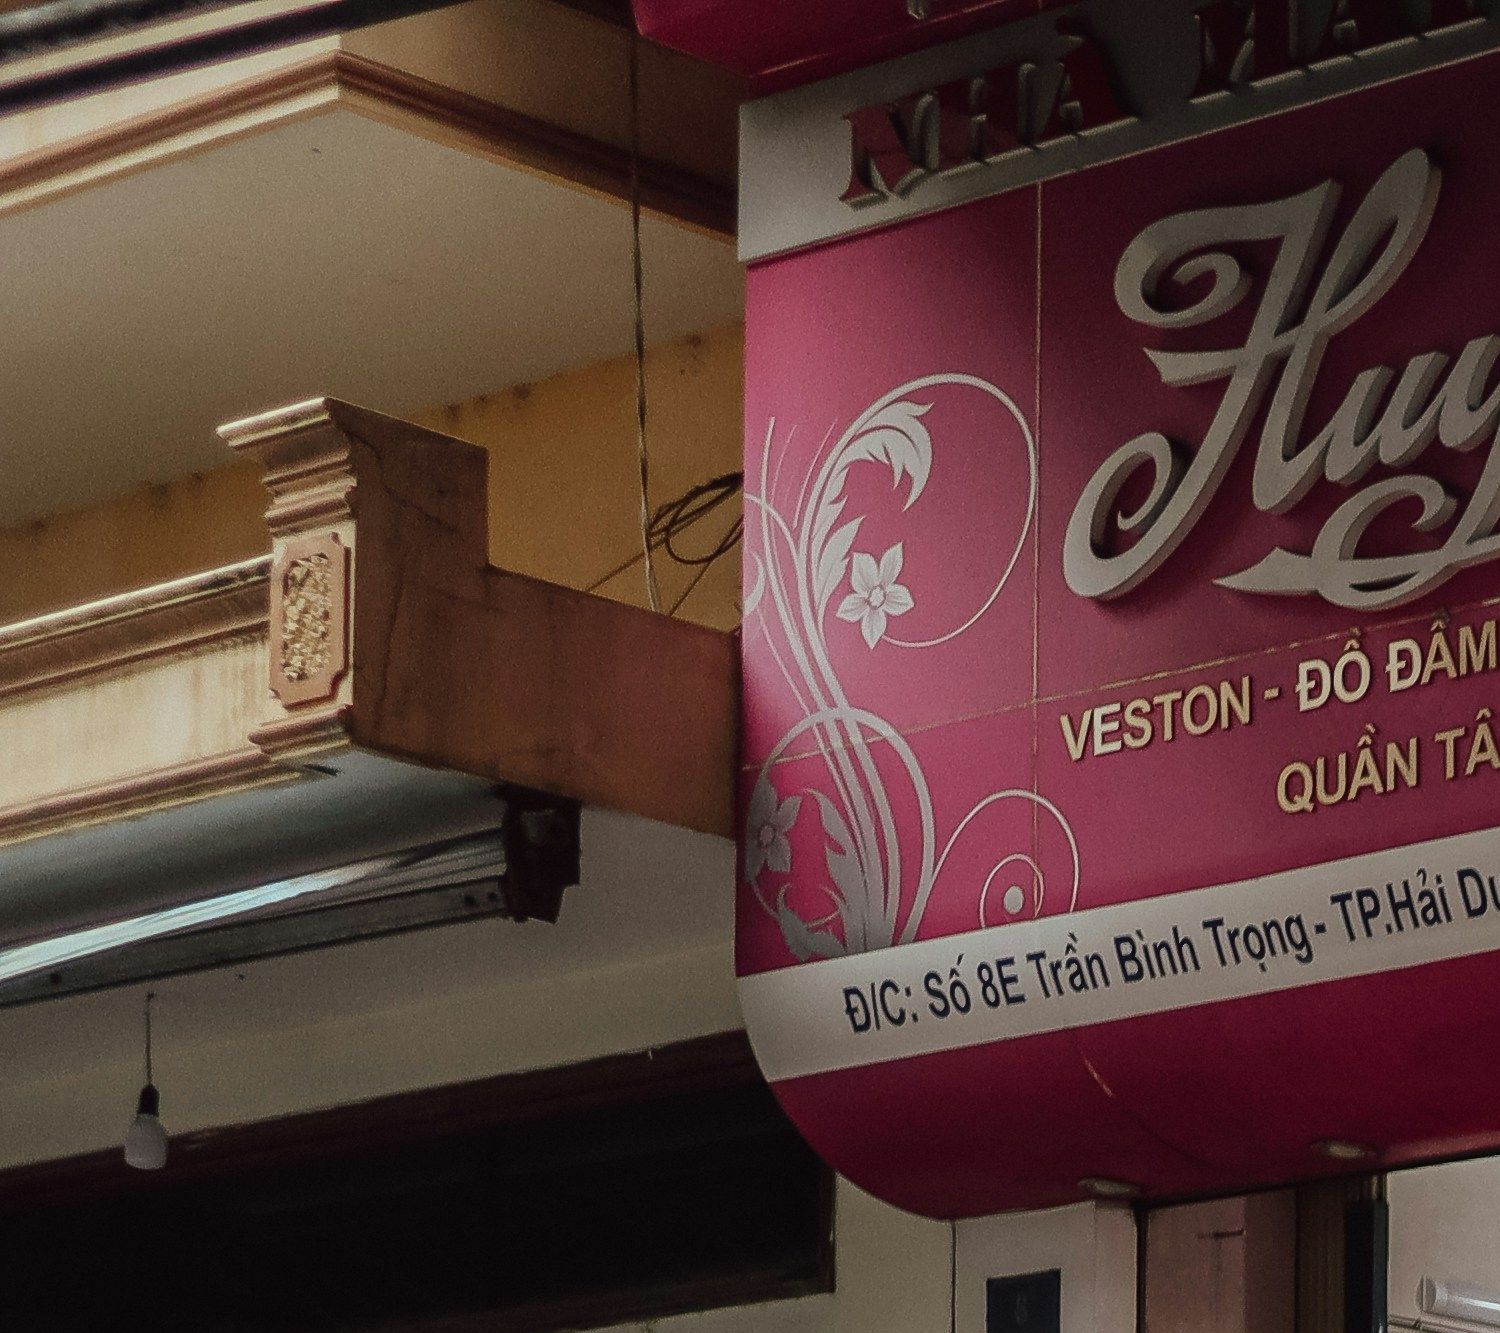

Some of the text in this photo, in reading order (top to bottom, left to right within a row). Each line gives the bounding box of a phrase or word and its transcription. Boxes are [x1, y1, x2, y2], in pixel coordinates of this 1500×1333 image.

[1059, 675, 1254, 763] VESTON
[1294, 626, 1372, 714] ĐỒ
[1385, 608, 1499, 694] ĐẦM
[1275, 722, 1420, 816] QUẦN
[841, 981, 920, 1034] Đ/C:
[925, 952, 970, 1019] Số
[976, 954, 1027, 1010] 8E
[1026, 932, 1112, 1002] Trần
[1117, 921, 1202, 986] Bình
[1203, 912, 1314, 972] Trọng
[1329, 866, 1454, 943] TP.Hải
